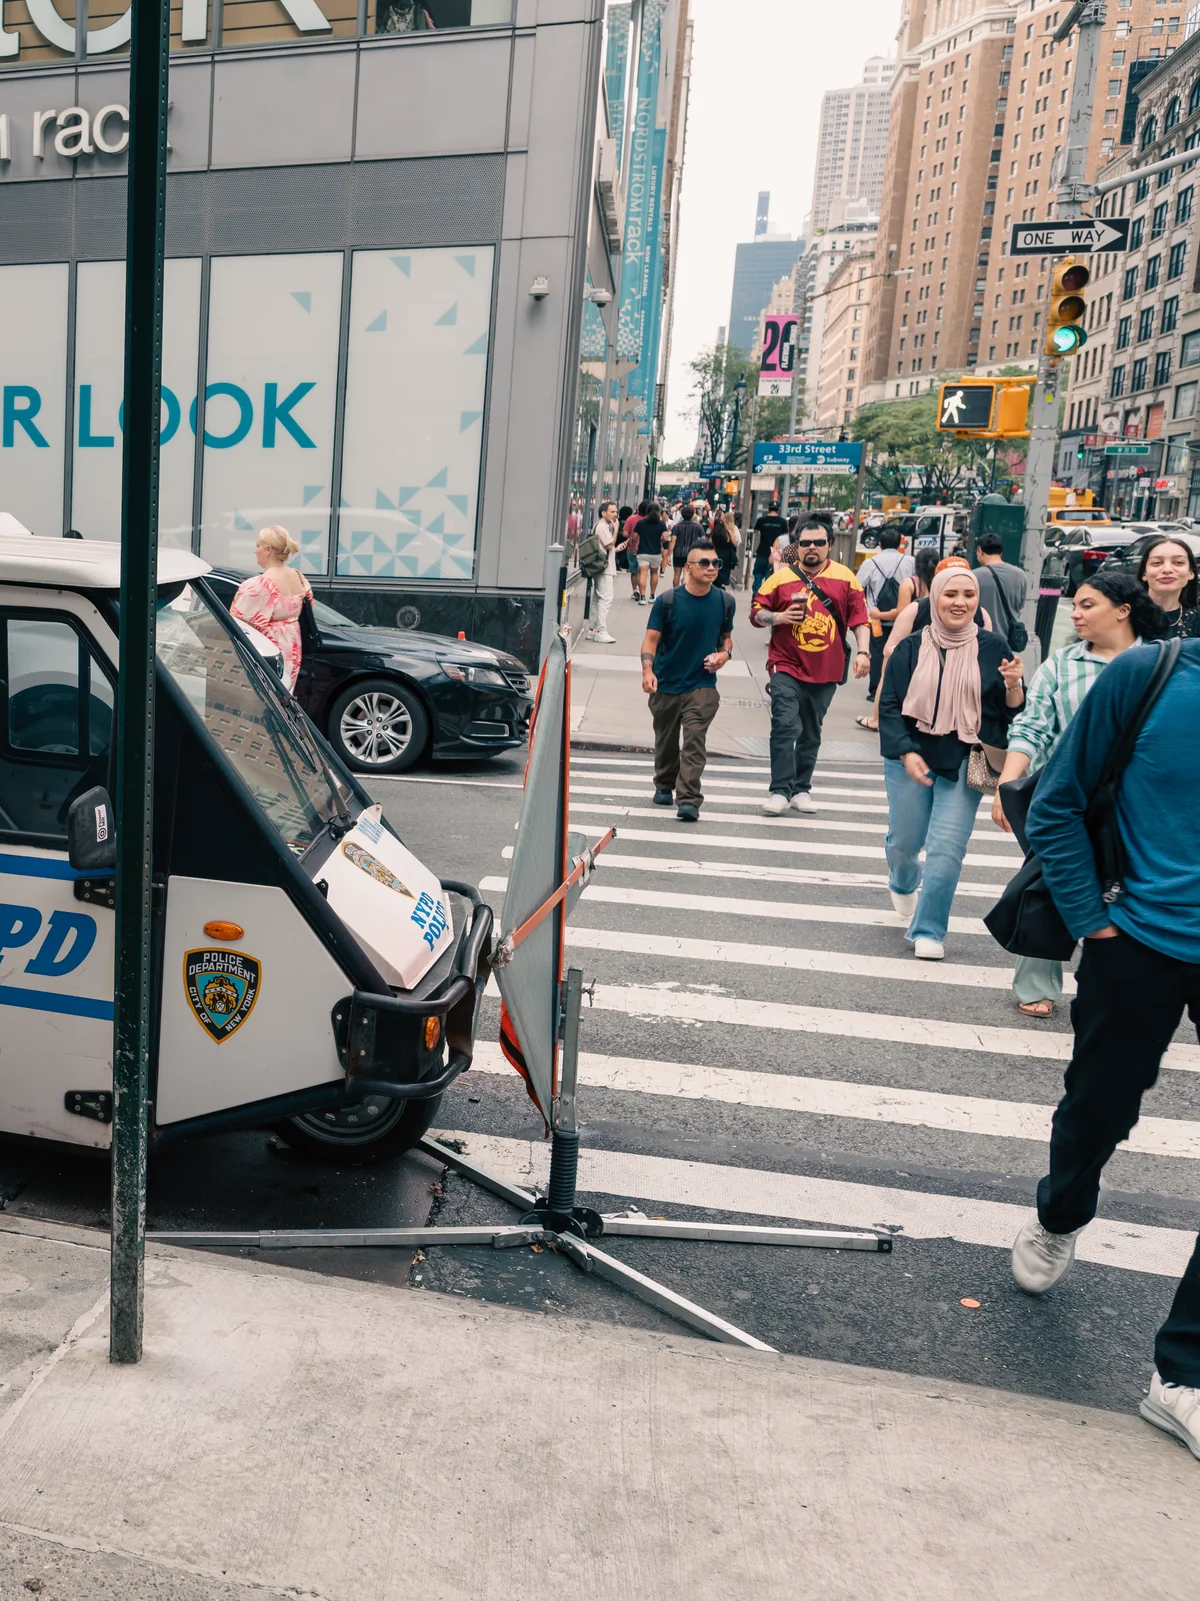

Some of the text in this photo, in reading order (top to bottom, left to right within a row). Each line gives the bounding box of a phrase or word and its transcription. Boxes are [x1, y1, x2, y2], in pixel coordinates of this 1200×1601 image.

[33, 102, 173, 160] rac
[625, 97, 651, 264] NORDSTROM rack
[647, 165, 657, 231] LUXURY RENTALS
[1023, 229, 1105, 246] ONE WAY
[779, 445, 836, 453] 33rd Street
[917, 539, 937, 547] NYPD
[410, 891, 435, 930] NYPD
[188, 962, 256, 983] DEPARTMENT
[203, 952, 243, 968] POLICE
[189, 986, 211, 1025] CITY OF
[224, 988, 255, 1032] NEW YORK
